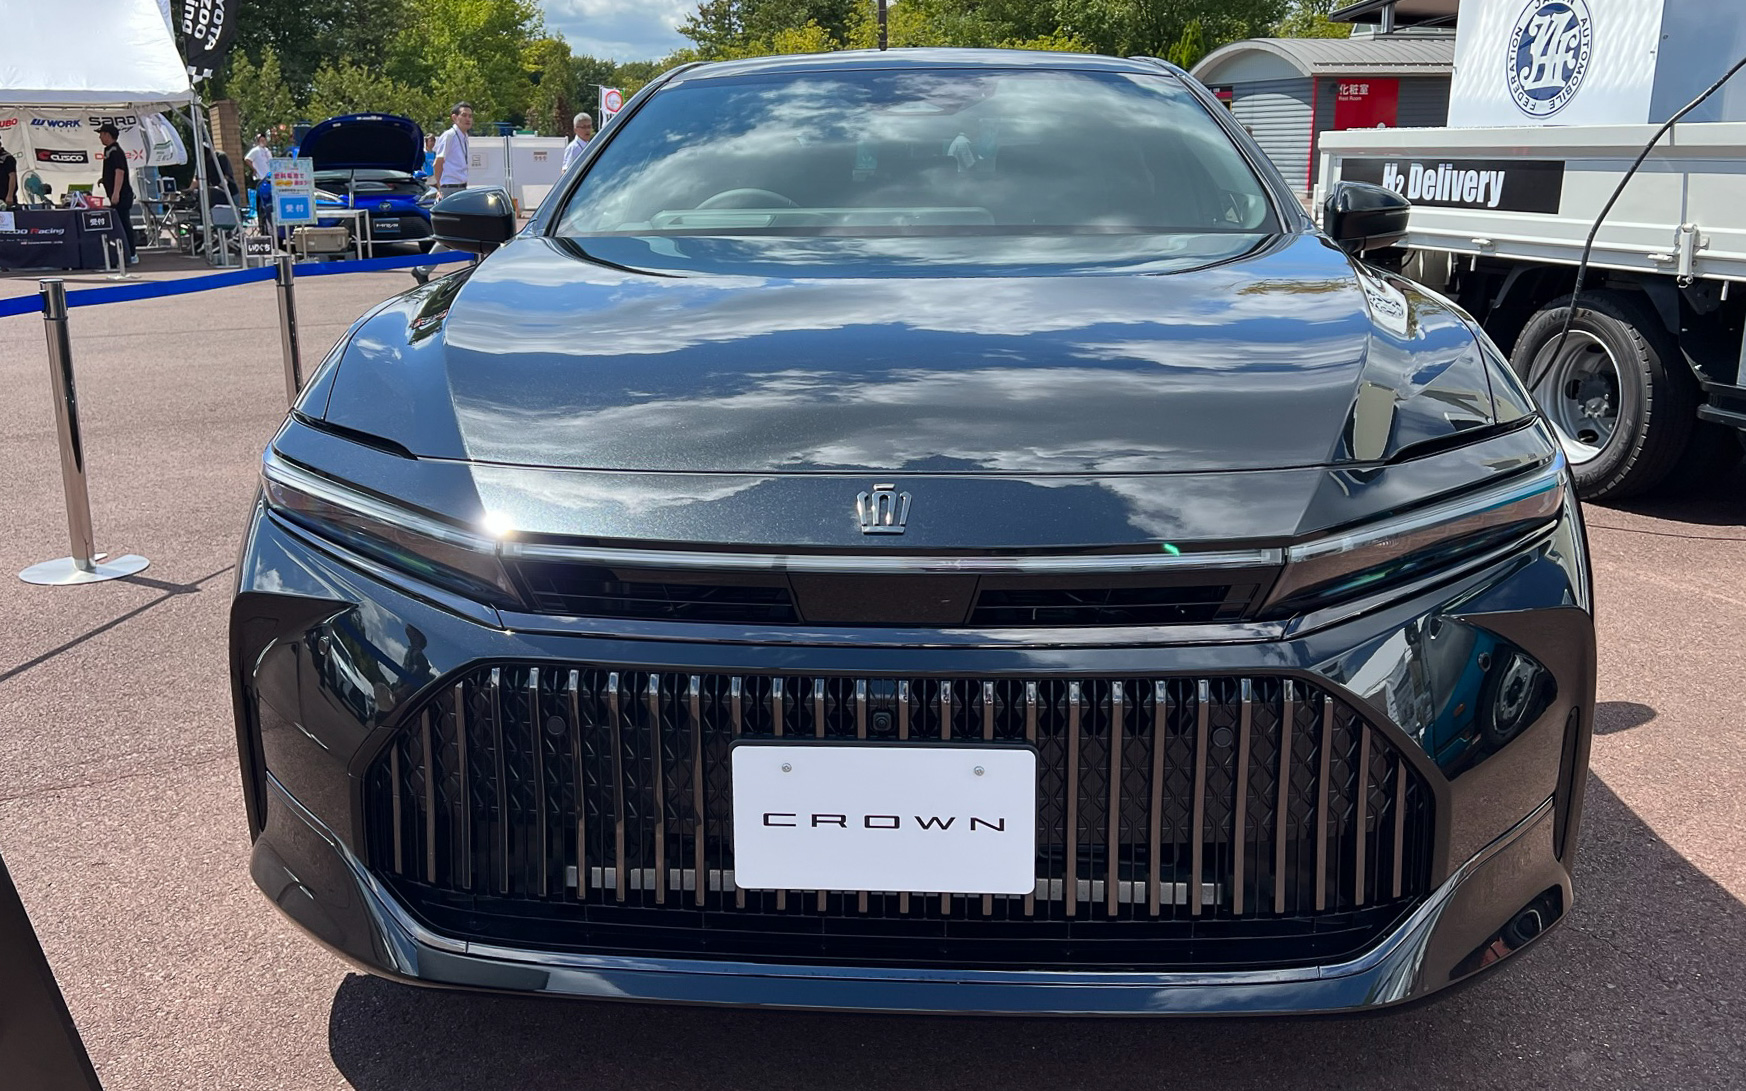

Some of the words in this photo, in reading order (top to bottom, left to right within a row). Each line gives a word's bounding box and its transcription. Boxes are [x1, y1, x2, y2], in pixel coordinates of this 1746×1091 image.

[1509, 26, 1537, 111] FEDERATION
[1549, 17, 1590, 110] AUTOMOBILE
[1339, 83, 1369, 95] 化粧室
[46, 119, 81, 128] WORK
[1407, 162, 1505, 208] Delivery
[30, 227, 65, 236] Racing
[763, 812, 1005, 832] CROWN
